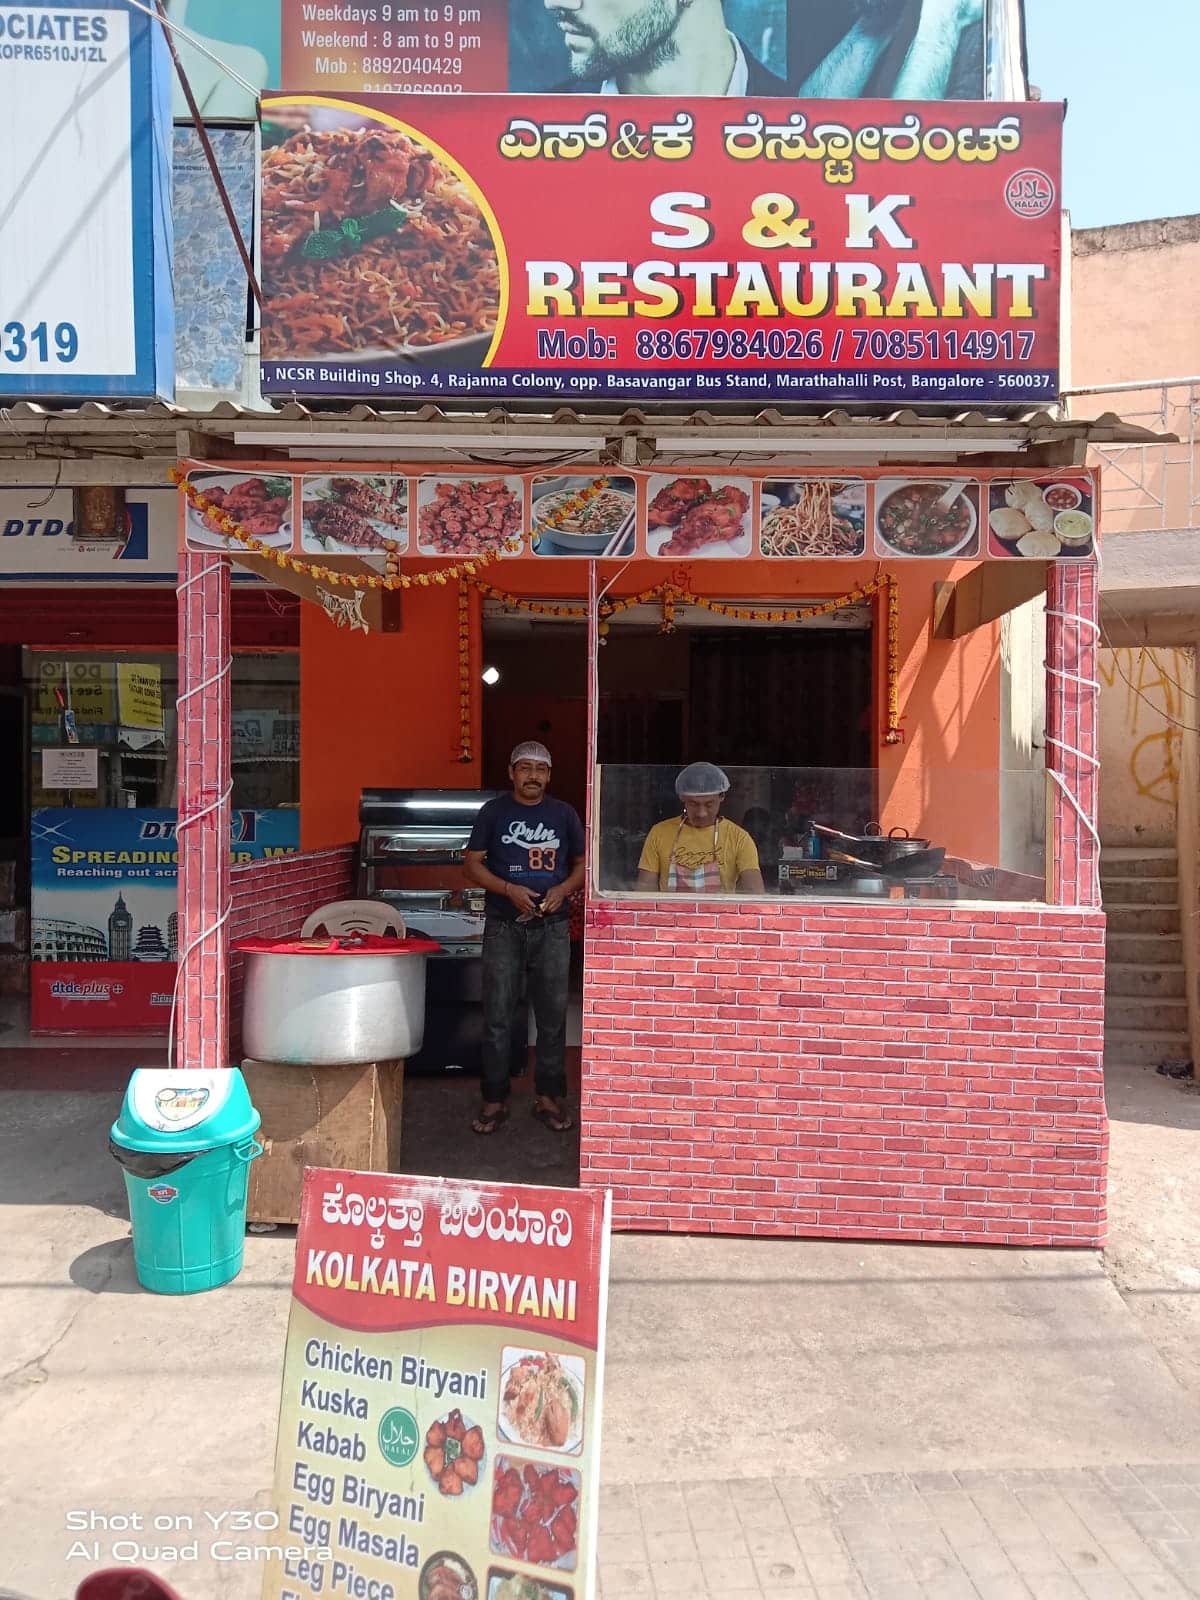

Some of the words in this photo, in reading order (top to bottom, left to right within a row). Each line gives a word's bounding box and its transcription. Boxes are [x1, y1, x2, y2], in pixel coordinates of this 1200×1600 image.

[0, 13, 108, 42] CIATES
[302, 4, 377, 25] Weekdays
[382, 4, 392, 22] 9
[397, 8, 419, 22] am
[424, 7, 438, 22] to
[443, 4, 453, 22] 9
[458, 8, 481, 26] pm
[302, 31, 368, 48] Weekend
[382, 31, 392, 48] 8
[398, 35, 419, 48] am
[424, 34, 439, 48] to
[444, 31, 454, 49] 9
[459, 35, 481, 51] pm
[315, 57, 347, 73] Mob
[362, 57, 462, 74] 8892040429
[723, 112, 1021, 185] ರೆಸ್ಟೋರೆಂಟ್
[649, 191, 713, 249] S
[741, 192, 815, 249] &
[844, 193, 915, 249] K
[1014, 200, 1045, 208] HALAL
[525, 259, 1047, 318] RESTAURANT
[0, 321, 79, 363] 319
[537, 327, 617, 360] Mob:
[635, 329, 824, 361] 8867984026
[830, 329, 844, 362] /
[852, 329, 1036, 361] 7085114917
[275, 368, 315, 381] NCSR
[320, 369, 380, 387] Building
[384, 372, 426, 388] Shop.
[430, 375, 444, 388] 4,
[448, 375, 507, 390] Rajanna
[512, 374, 565, 389] Colony,
[570, 377, 602, 391] opp.
[607, 375, 692, 391] Basavangar
[696, 374, 722, 388] Bus
[726, 374, 772, 389] Stand,
[776, 374, 869, 388] Marathahalli
[873, 375, 907, 389] Post,
[911, 375, 984, 391] Bangalore
[998, 375, 1055, 388] 560037.
[57, 868, 123, 878] Reaching
[127, 869, 150, 877] out
[154, 869, 178, 877] acr
[528, 847, 557, 872] 83
[51, 981, 81, 993] dtdc
[82, 980, 111, 996] plus
[306, 1249, 436, 1302] KOLKATA
[446, 1266, 577, 1321] BIRYANI
[305, 1339, 392, 1382] Chicken
[400, 1356, 487, 1399] Biryani
[301, 1380, 369, 1420] Kuska
[297, 1421, 366, 1462] Kabab
[293, 1462, 335, 1501] Egg
[342, 1474, 425, 1522] Biryani
[289, 1503, 331, 1547] Egg
[337, 1517, 419, 1568] Masala
[285, 1557, 324, 1592] Leg
[332, 1561, 395, 1600] Piece
